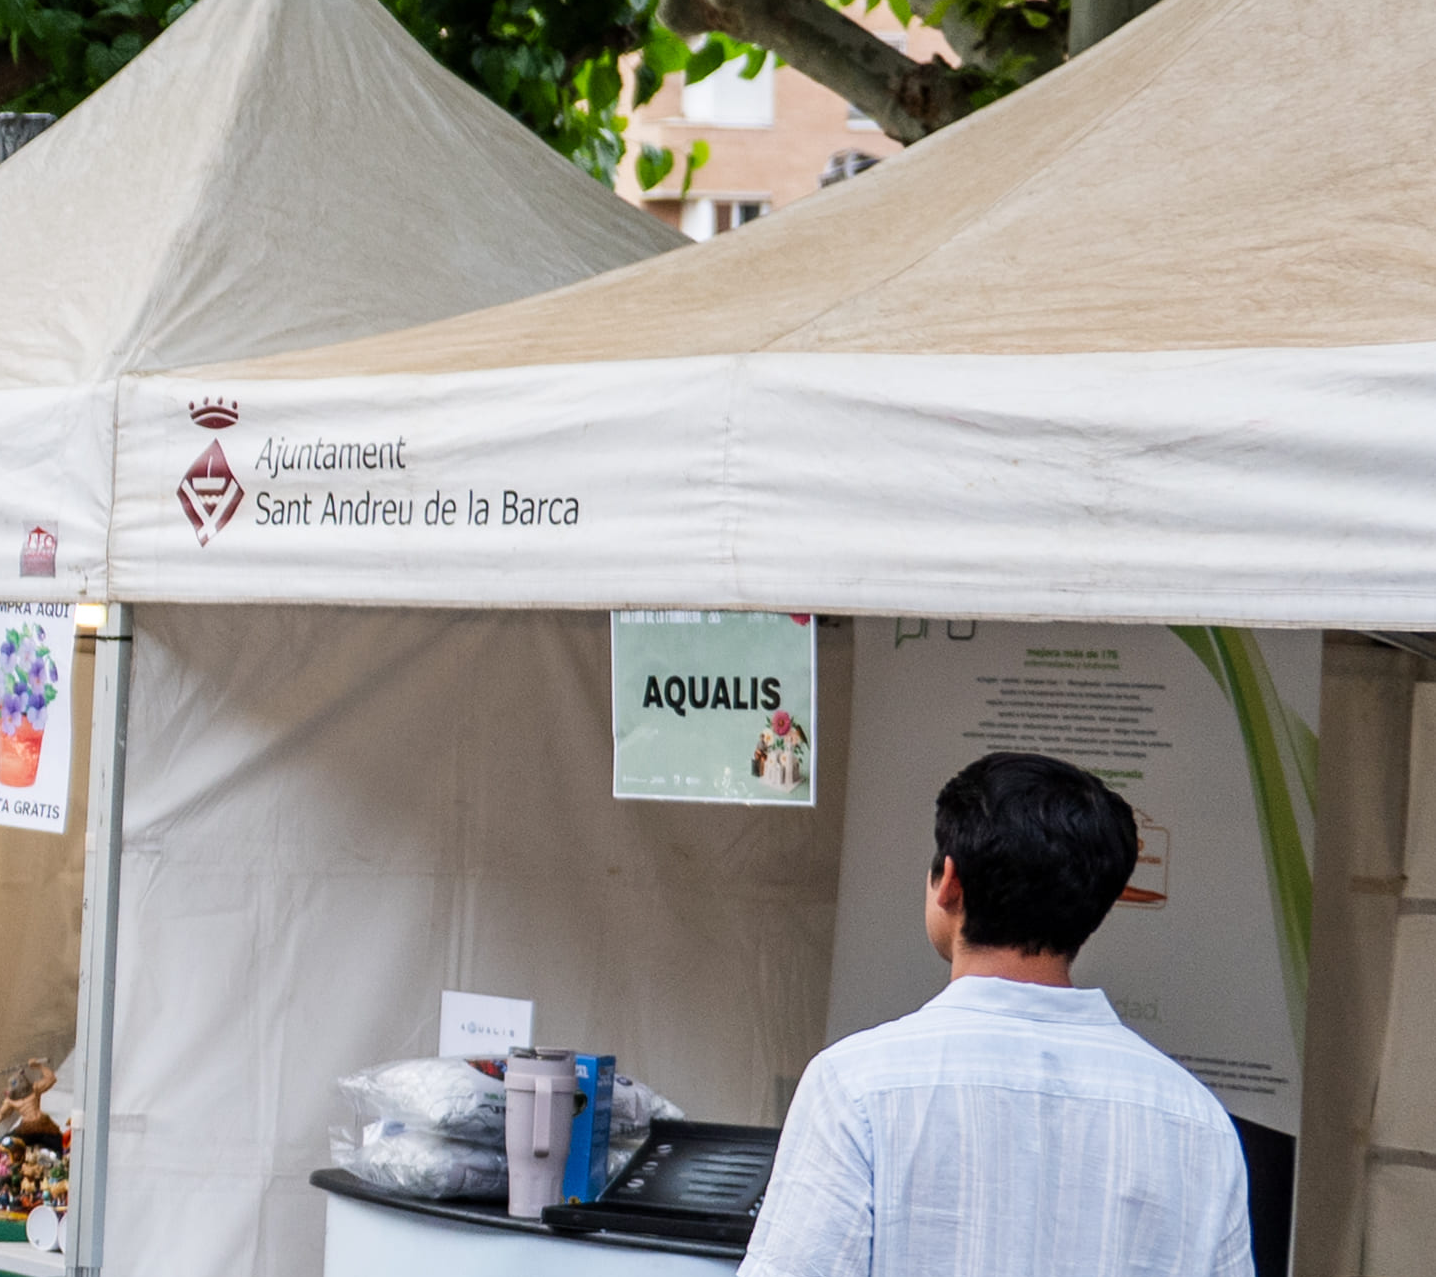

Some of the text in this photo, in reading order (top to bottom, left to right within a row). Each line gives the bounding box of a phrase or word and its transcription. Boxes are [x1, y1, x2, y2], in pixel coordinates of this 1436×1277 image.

[255, 436, 407, 479] Ajuntament
[255, 489, 580, 526] Sant Andreu de la Barca
[643, 675, 781, 717] AQUALIS
[14, 800, 61, 820] GRATIS
